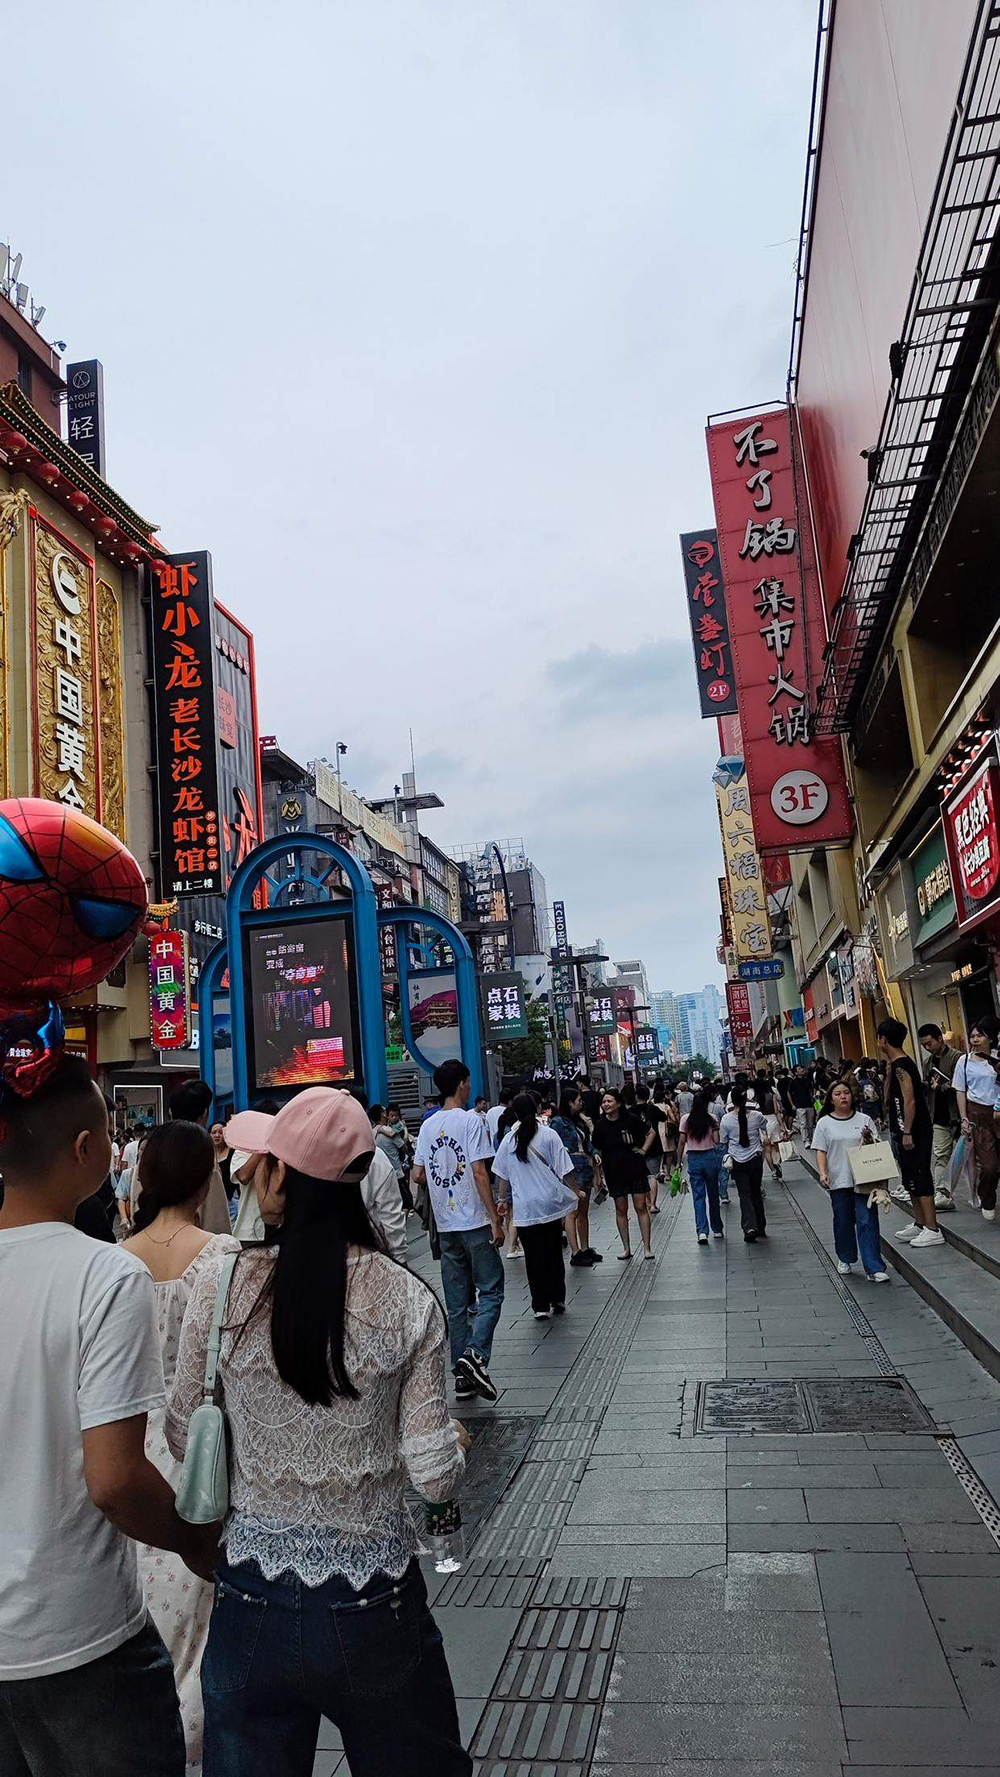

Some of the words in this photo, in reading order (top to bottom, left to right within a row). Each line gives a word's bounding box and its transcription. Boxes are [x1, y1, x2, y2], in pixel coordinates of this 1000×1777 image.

[69, 391, 96, 403] ATOUR
[69, 400, 96, 411] LIGHT
[733, 421, 797, 561] 不了锅
[753, 576, 811, 747] 集市火锅
[709, 684, 727, 698] 2F
[778, 779, 820, 812] 3F
[955, 788, 991, 854] 黑色经典
[725, 786, 768, 953] 周六福珠宝
[172, 879, 214, 893] 请上二楼
[740, 963, 783, 977] 湖南总店
[156, 939, 178, 1040] 中国黄金
[487, 985, 518, 1004] 点石
[488, 1003, 521, 1021] 家装
[589, 1010, 614, 1022] 家装
[637, 1033, 653, 1042] 点石
